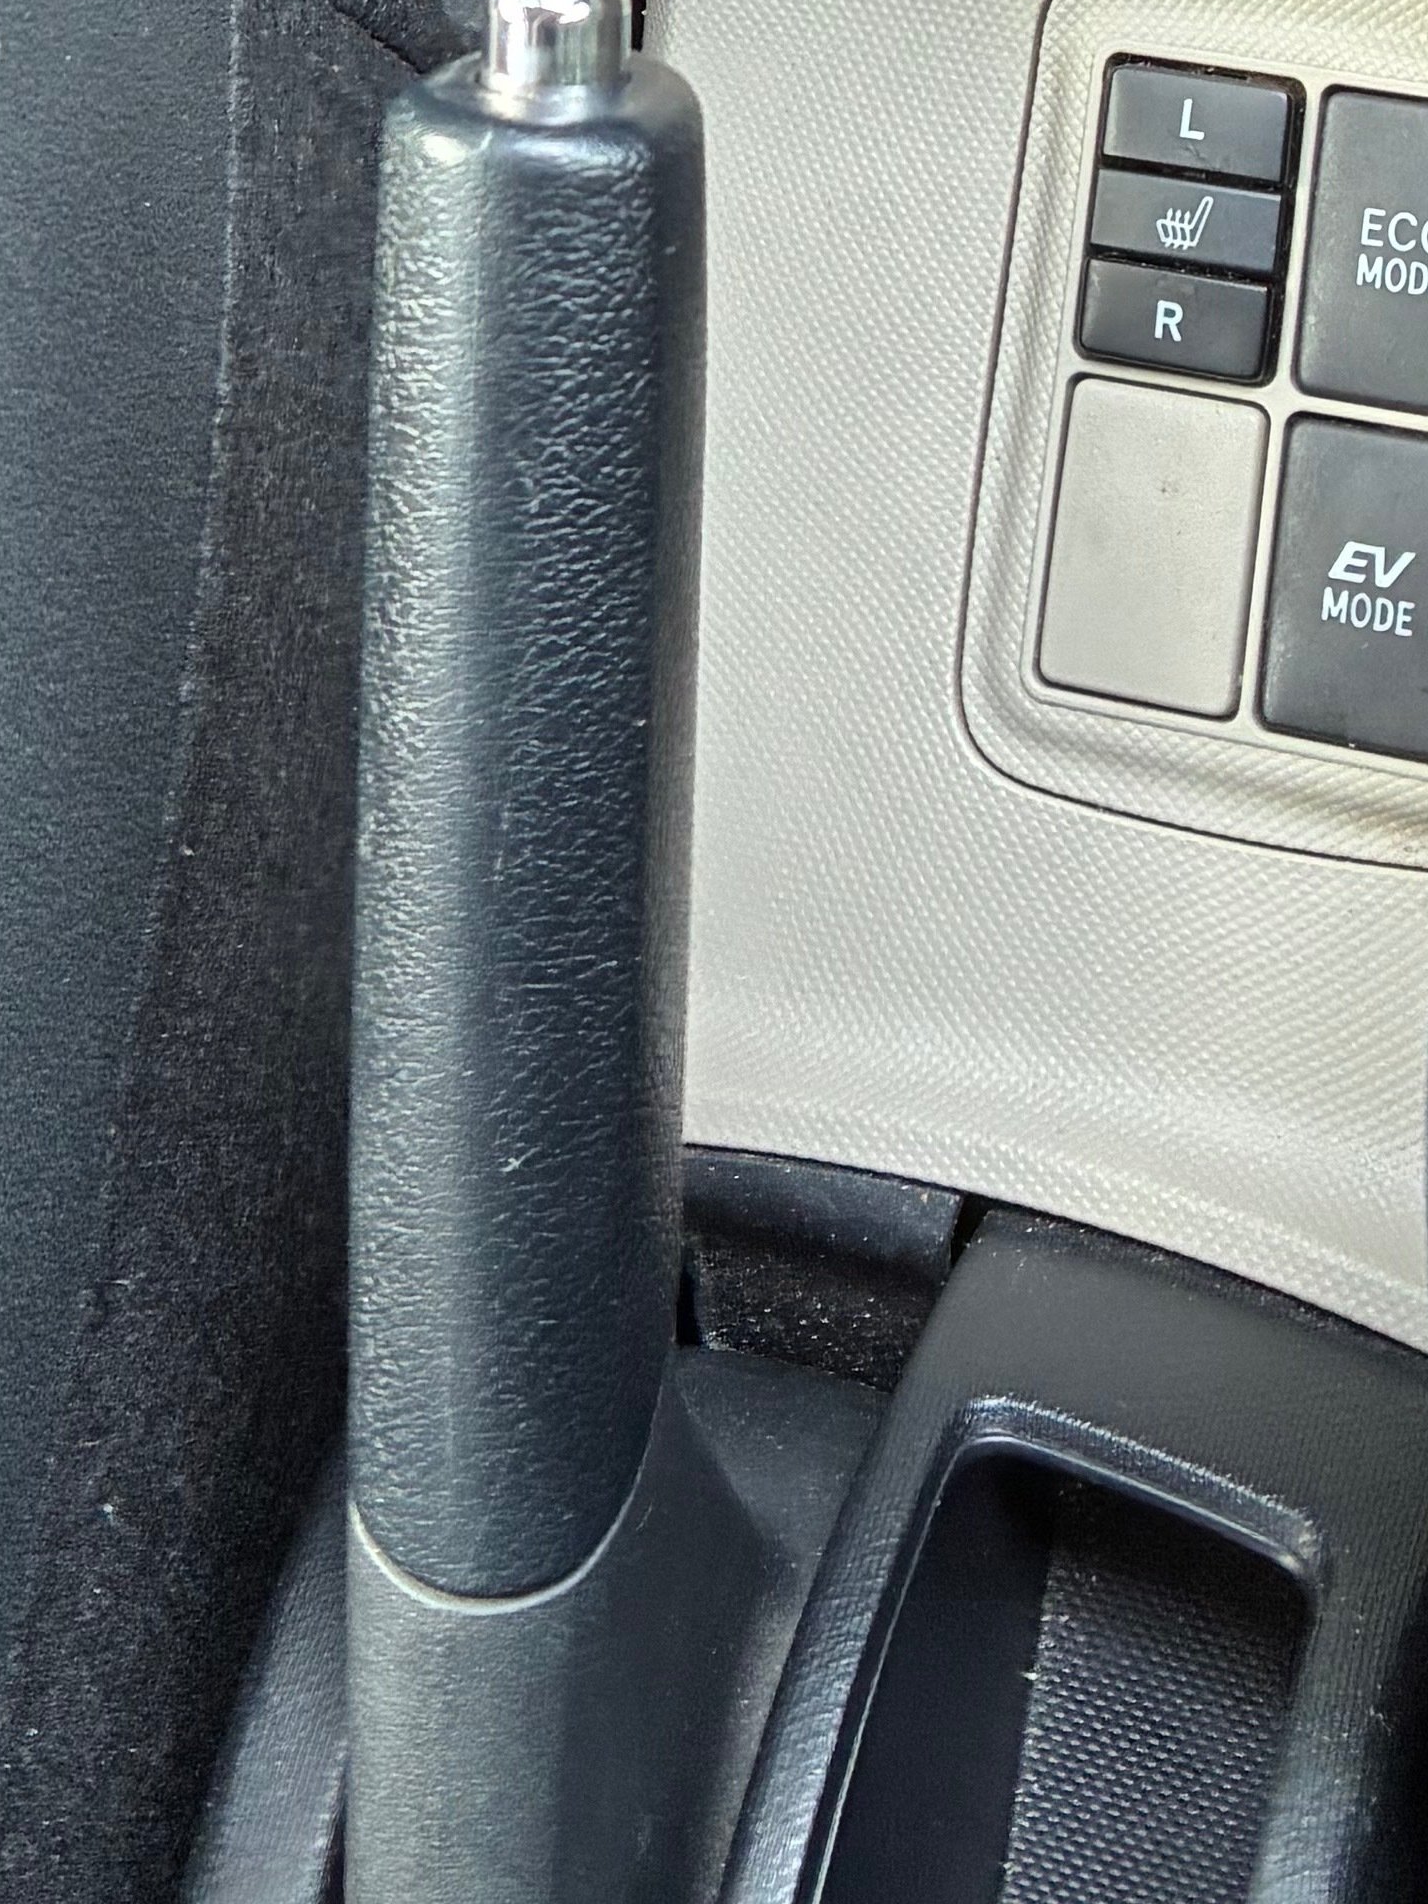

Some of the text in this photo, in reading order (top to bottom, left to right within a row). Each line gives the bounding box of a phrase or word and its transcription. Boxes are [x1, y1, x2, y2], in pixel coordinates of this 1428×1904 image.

[1178, 98, 1205, 141] L
[1154, 299, 1184, 342] R
[1327, 540, 1416, 588] EV
[1320, 586, 1416, 637] MODE
